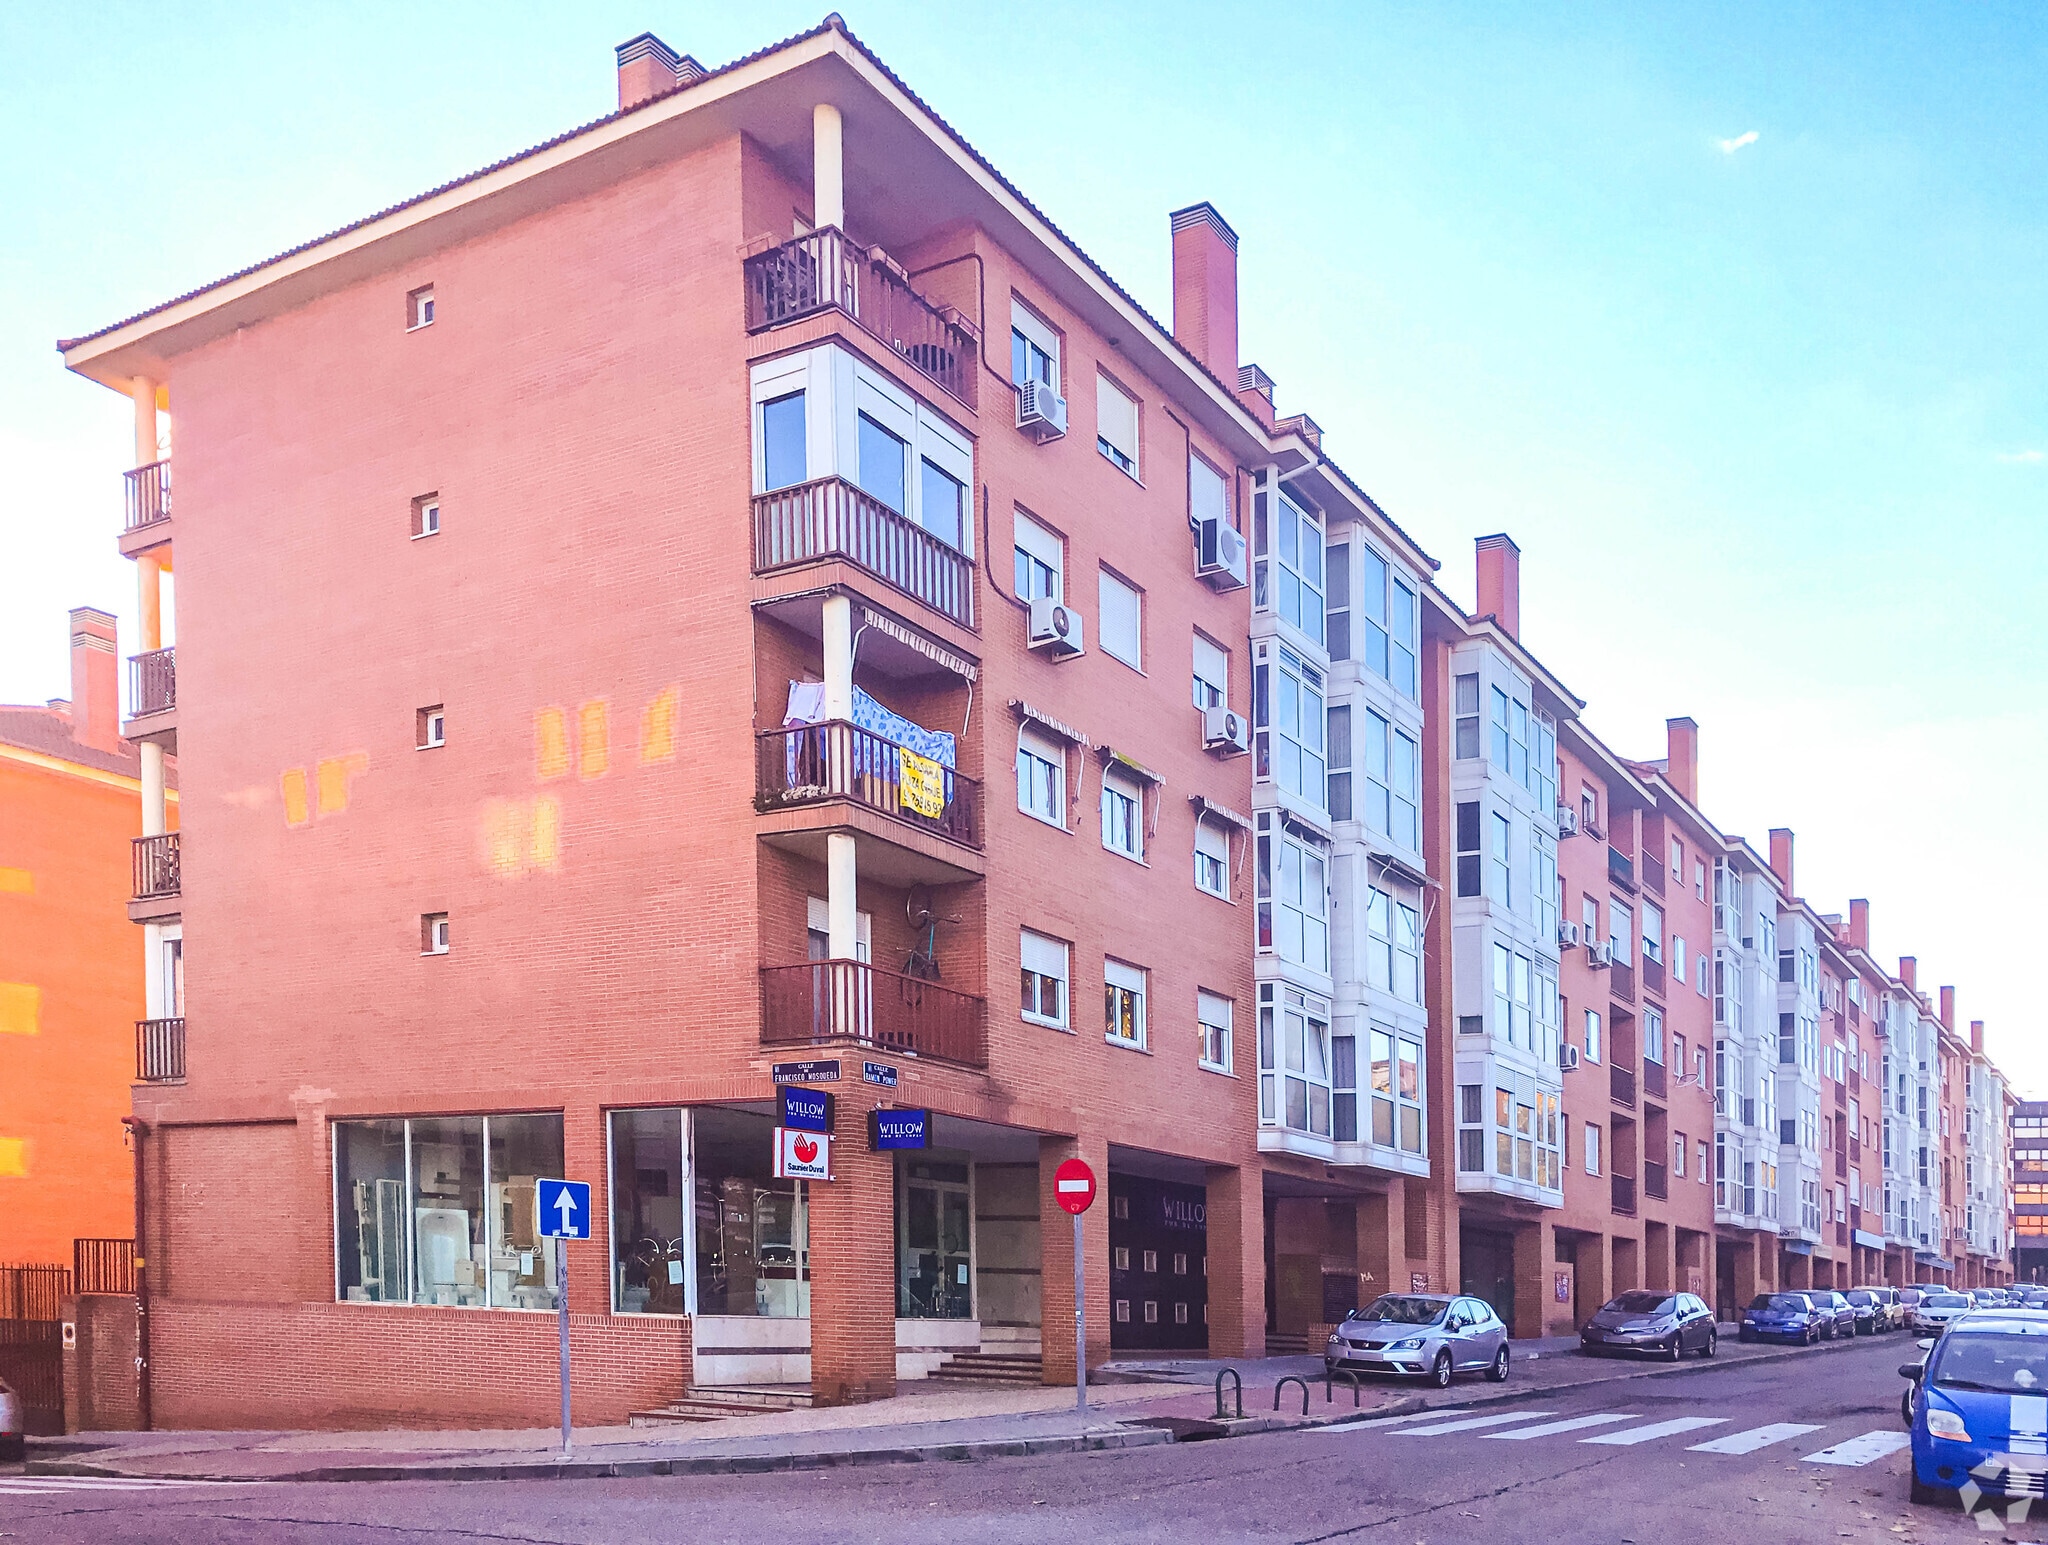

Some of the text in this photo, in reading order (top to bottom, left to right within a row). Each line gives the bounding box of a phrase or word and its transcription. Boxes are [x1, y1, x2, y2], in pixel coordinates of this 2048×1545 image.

[901, 753, 911, 769] SE
[873, 1065, 889, 1073] CALLE
[774, 1071, 838, 1082] FRANCISCO MOSQUEDA
[786, 1098, 825, 1116] WILLOW
[879, 1121, 923, 1134] WILLOW
[787, 1162, 825, 1174] Saunier Duval
[1163, 1196, 1206, 1222] WILLO
